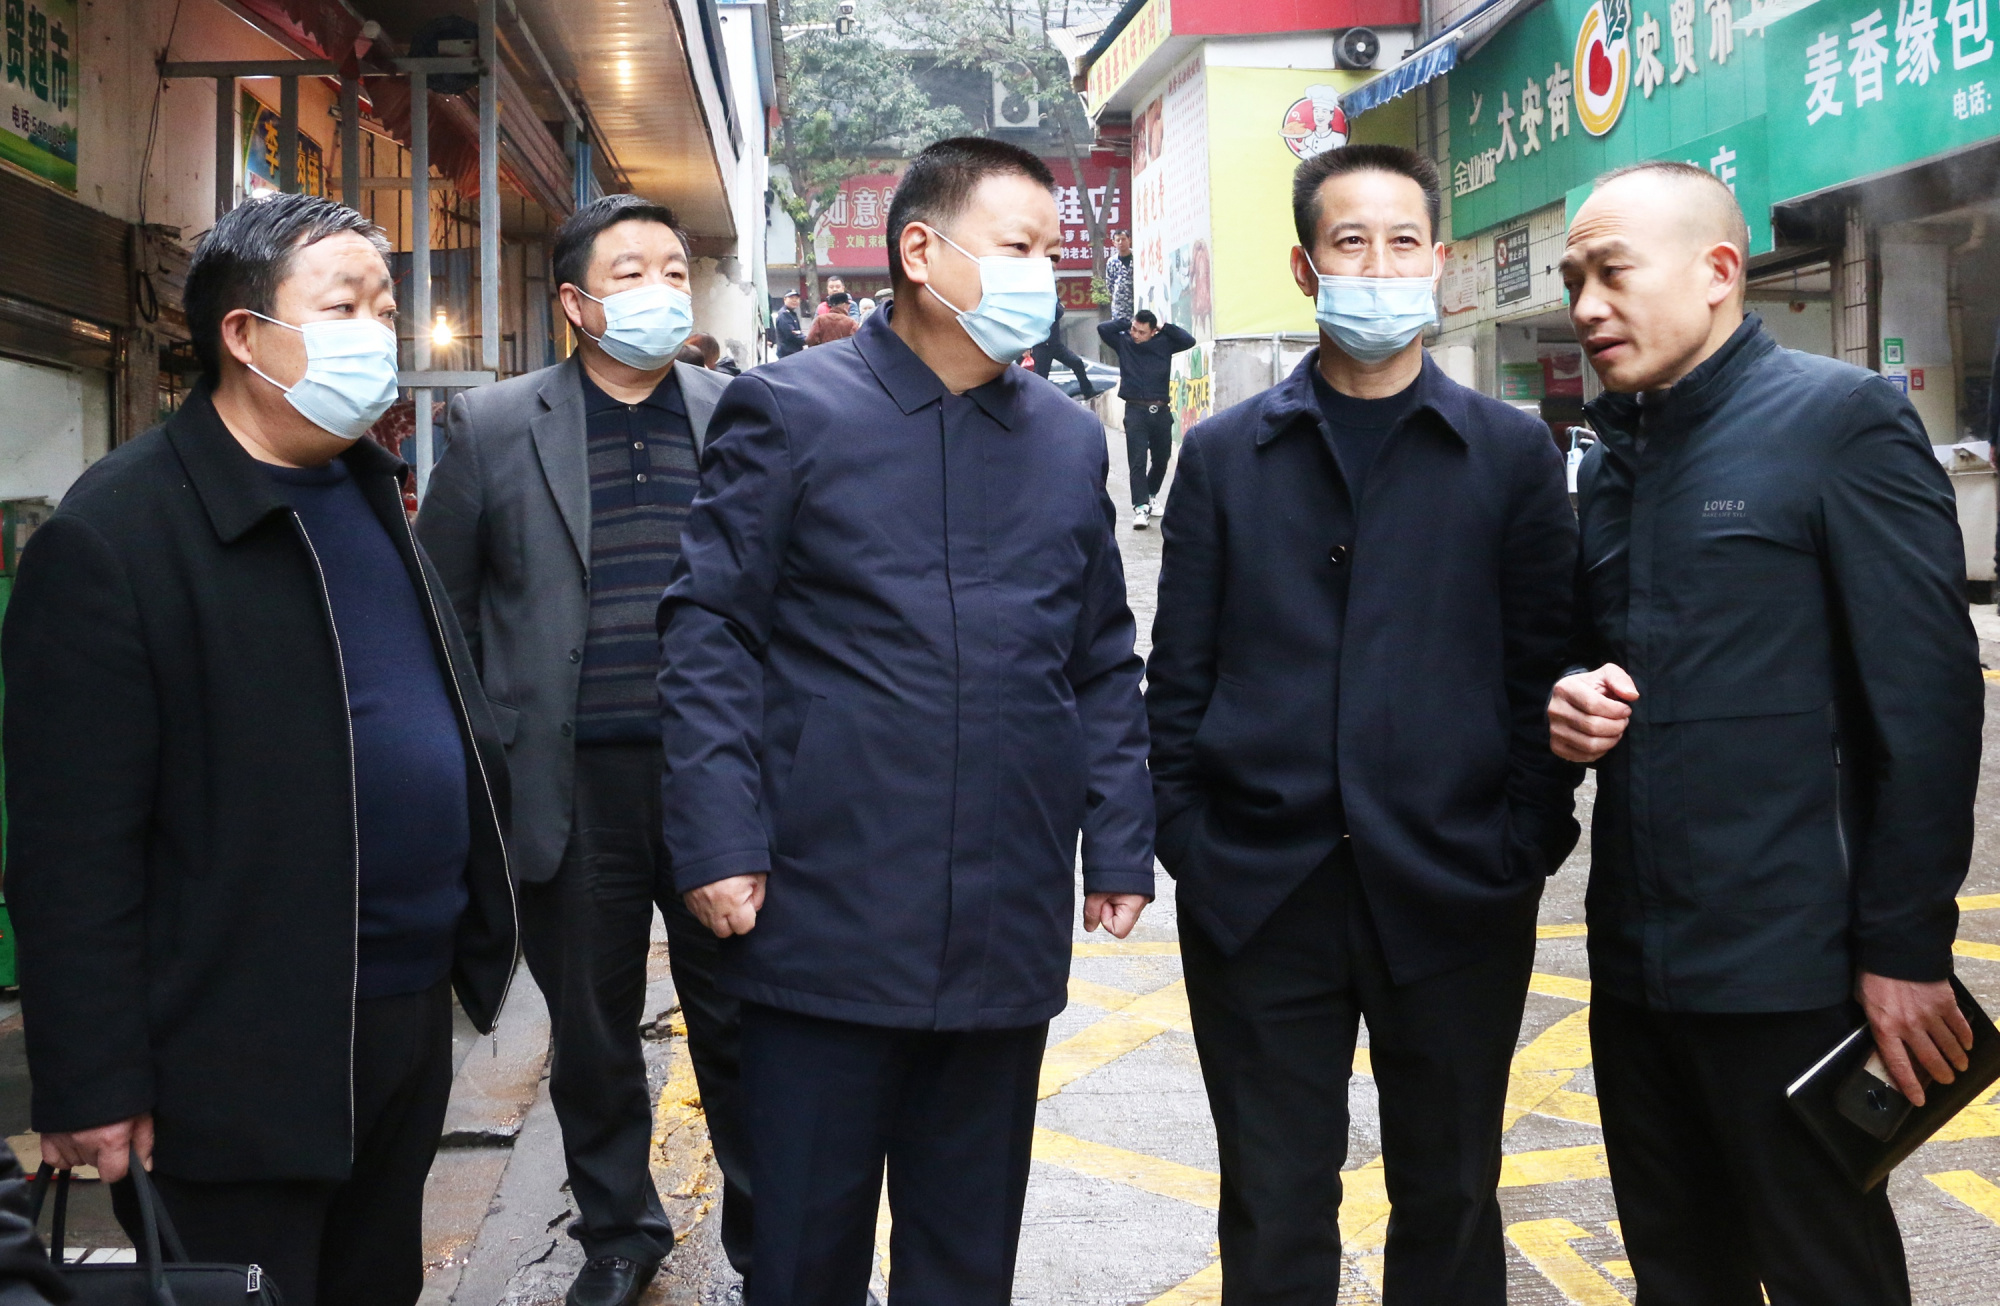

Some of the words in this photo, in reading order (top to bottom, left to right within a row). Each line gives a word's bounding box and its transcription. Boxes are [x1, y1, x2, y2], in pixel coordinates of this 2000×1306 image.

[0, 0, 69, 112] 贸超市
[1804, 0, 1994, 126] 麦香缘包
[1497, 61, 1572, 164] 大安街
